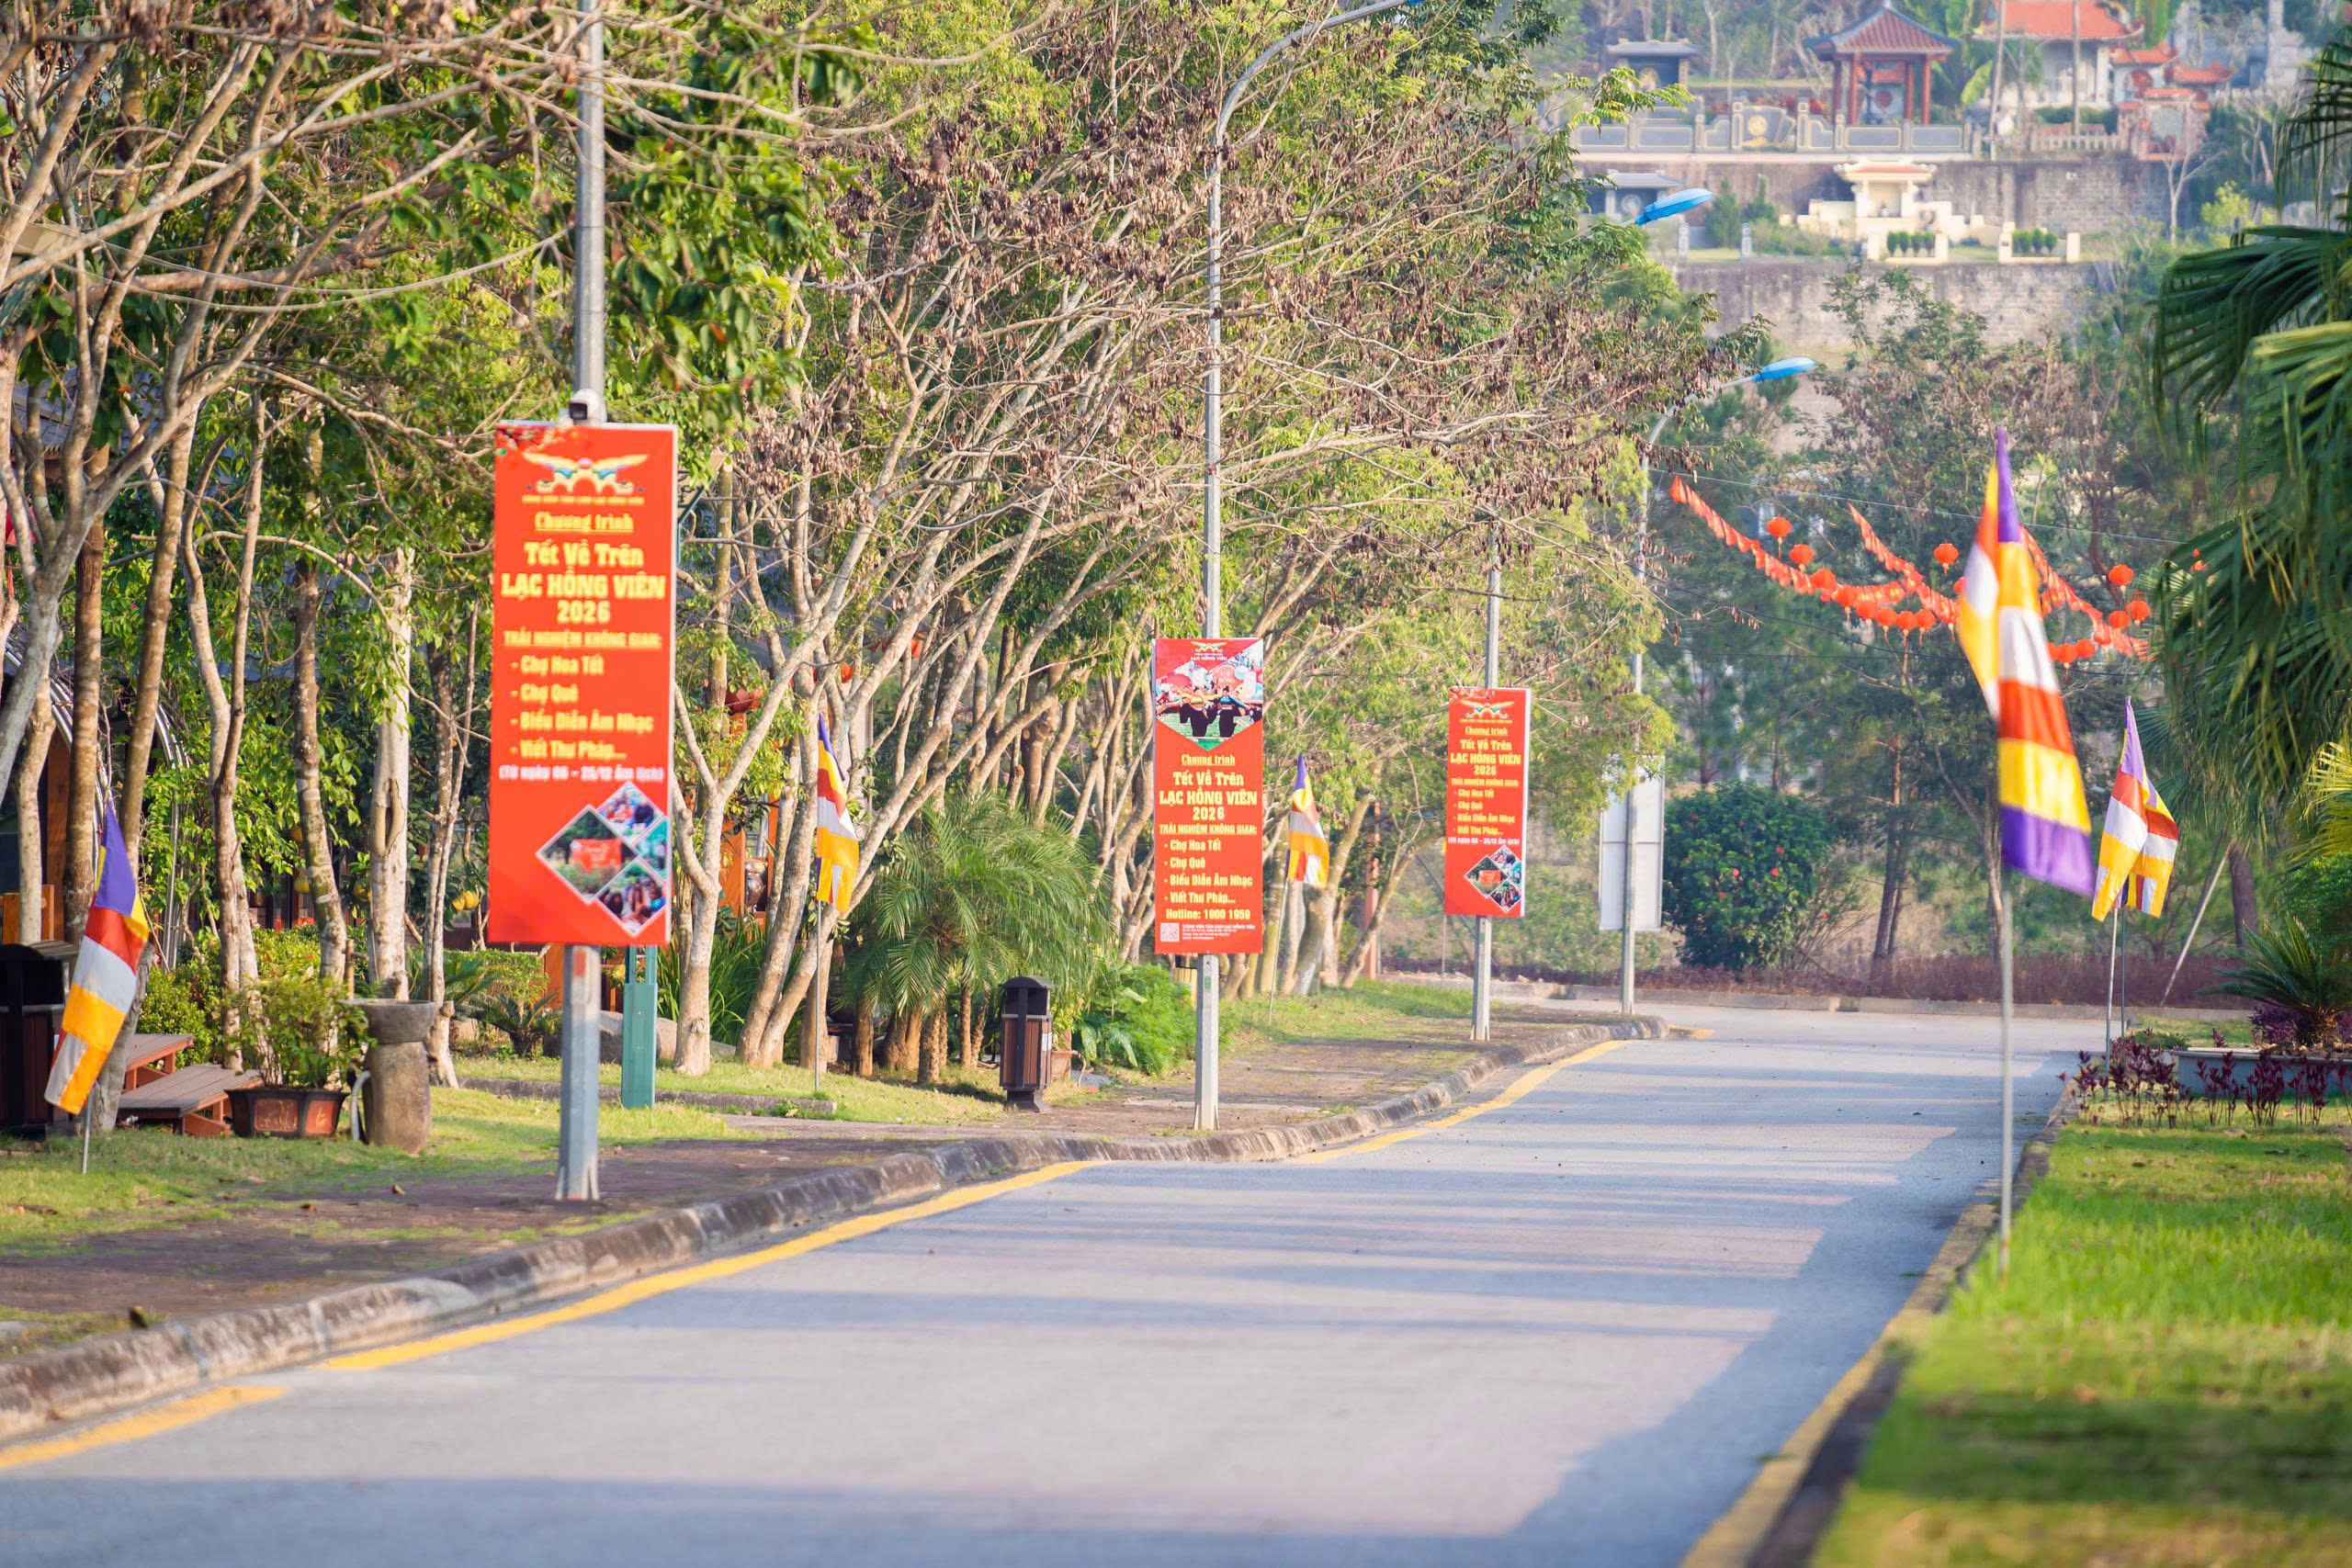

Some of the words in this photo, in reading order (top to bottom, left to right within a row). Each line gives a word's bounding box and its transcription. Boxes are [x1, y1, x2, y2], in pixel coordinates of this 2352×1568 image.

[535, 513, 591, 533] Chương
[595, 513, 633, 531] trình
[524, 538, 559, 566] Tết
[563, 539, 590, 566] Về
[594, 544, 644, 567] Trên
[501, 573, 542, 600] LẠC
[547, 566, 607, 598] HỒNG
[614, 571, 666, 599] VIÊN
[557, 600, 610, 623] 2026
[521, 655, 548, 676] Chợ
[551, 655, 579, 673] Hoa
[582, 653, 604, 674] Tết
[521, 683, 548, 704] Chợ
[551, 683, 579, 703] Quê
[520, 708, 553, 730] Biểu
[590, 709, 614, 730] Âm
[616, 713, 653, 734] Nhạc
[520, 738, 548, 758] Viết
[550, 740, 575, 759] Thư
[1461, 738, 1475, 750] Tết
[1477, 738, 1488, 750] Về
[1490, 740, 1511, 750] Trên
[1182, 754, 1212, 766] Chương
[1215, 754, 1235, 764] trình
[1451, 752, 1467, 764] LẠC
[1470, 750, 1496, 763] HỒNG
[1498, 752, 1521, 764] VIÊN
[1475, 764, 1497, 775] 2026
[1173, 770, 1193, 785] Tết
[1196, 769, 1213, 785] Về
[1216, 771, 1243, 785] Trên
[1159, 791, 1183, 807] LẠC
[1187, 786, 1222, 805] HỒNG
[1226, 789, 1257, 805] VIÊN
[1193, 807, 1225, 820] 2026
[1159, 822, 1176, 834] TRẢI
[1178, 823, 1207, 835] NGHIỆM
[1209, 823, 1235, 834] KHÔNG
[1170, 840, 1187, 852] Chợ
[1189, 840, 1205, 851] Hoa
[1208, 838, 1221, 851] Tết
[1170, 857, 1187, 870] Chợ
[1189, 857, 1205, 868] Quê
[1170, 873, 1189, 886] Biểu
[1192, 874, 1211, 886] Diễn
[1214, 874, 1228, 886] Âm
[1230, 875, 1252, 887] Nhạc
[1170, 891, 1187, 903] Viết
[1189, 892, 1204, 903] Thư
[1166, 908, 1201, 919] Hotline:
[1204, 909, 1226, 919] 1900
